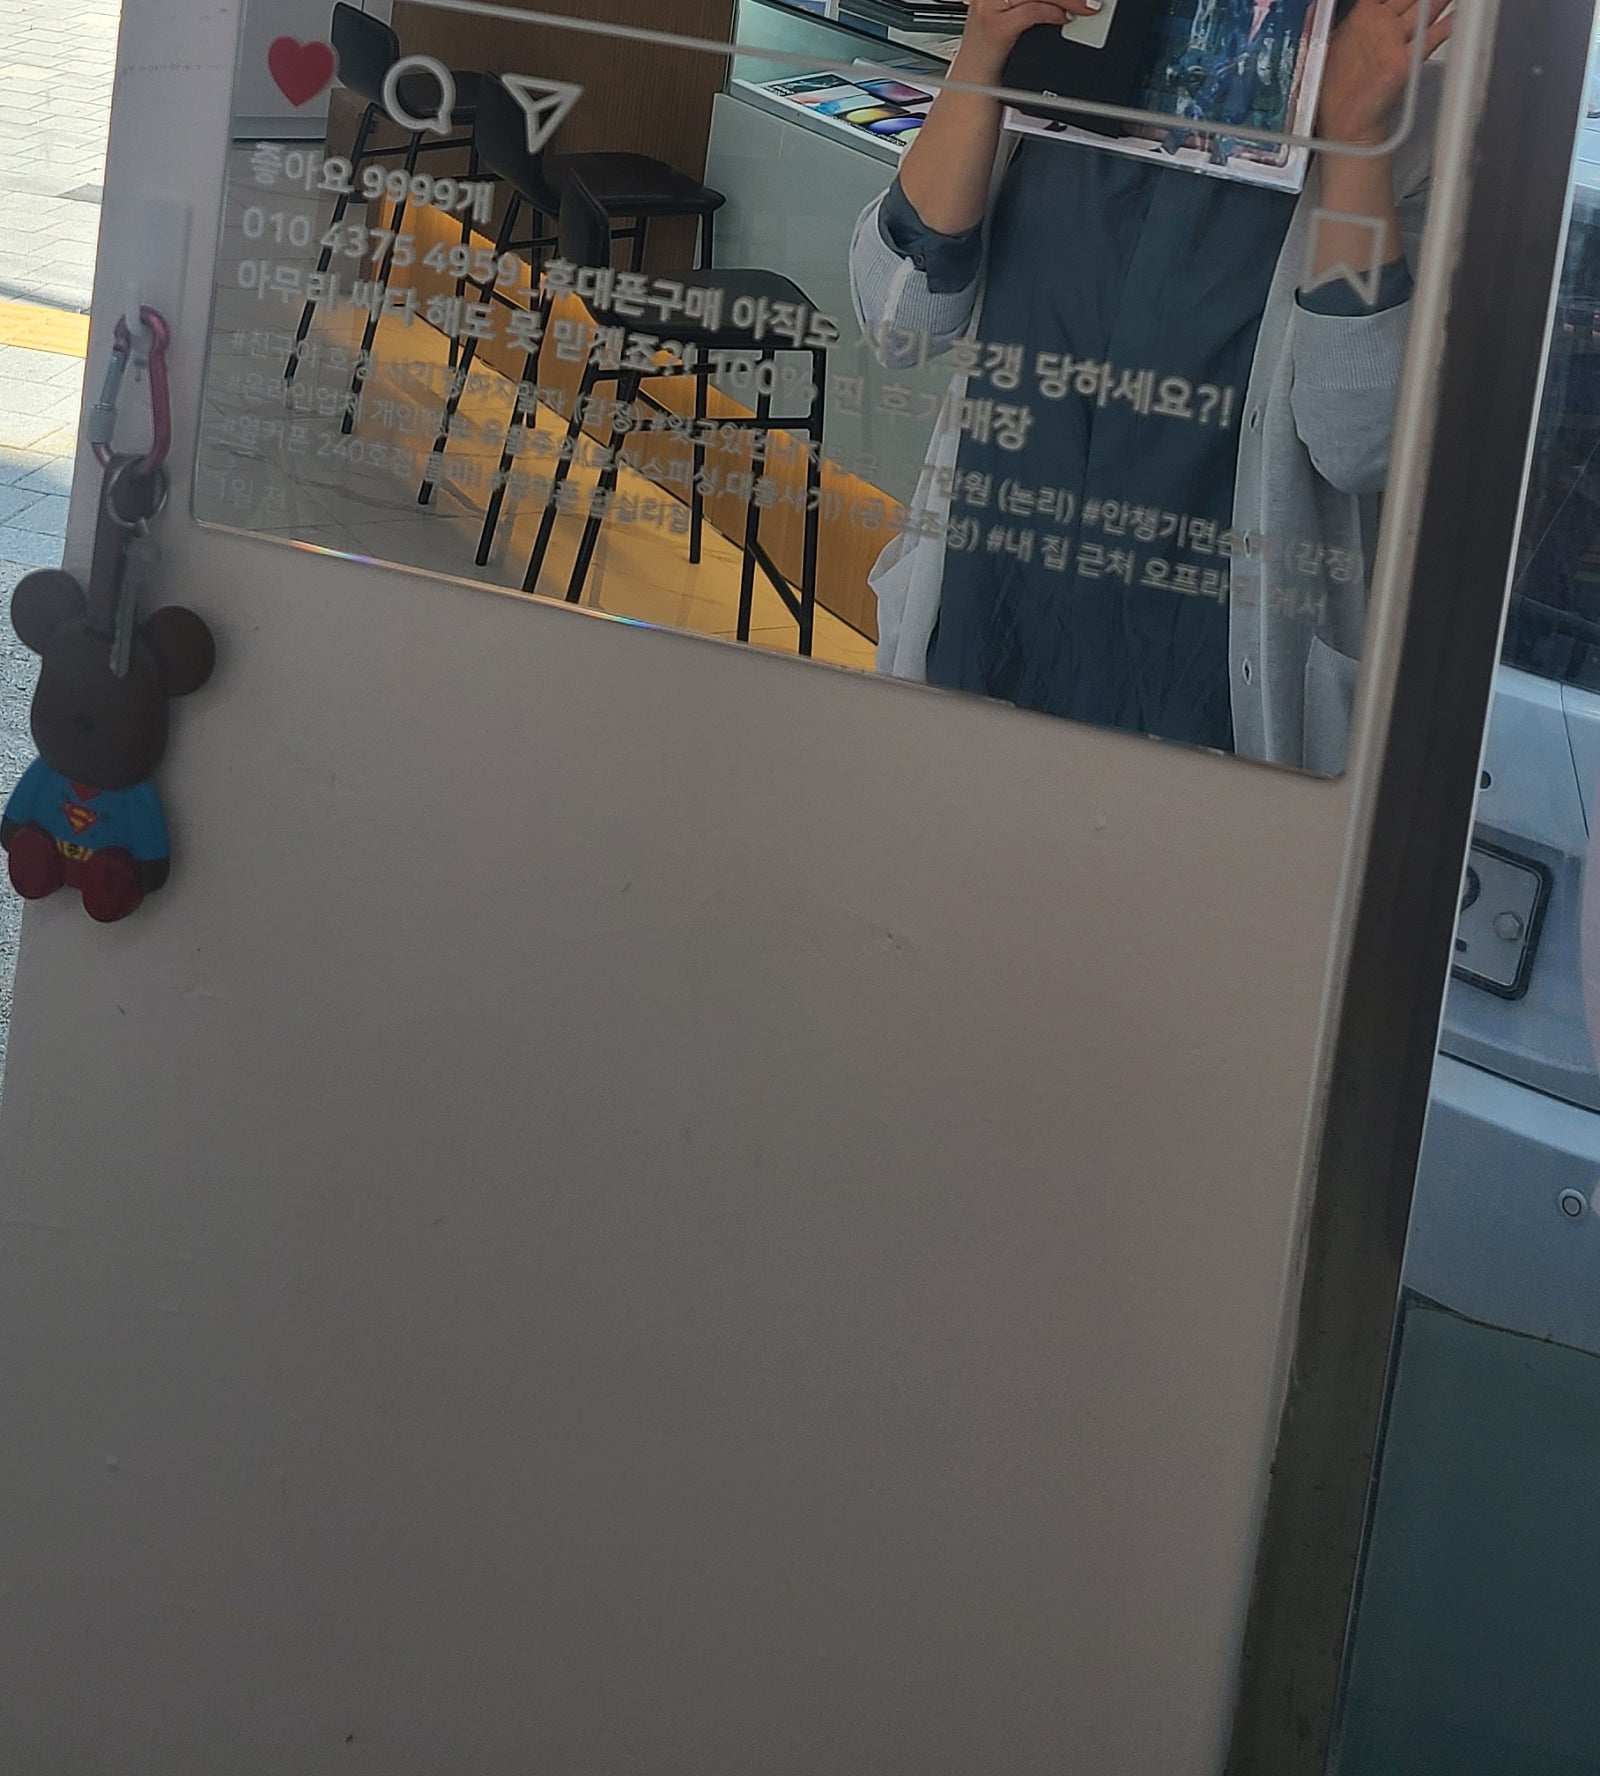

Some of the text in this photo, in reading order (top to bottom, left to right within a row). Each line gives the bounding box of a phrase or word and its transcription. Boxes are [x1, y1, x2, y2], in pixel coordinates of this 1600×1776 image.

[250, 141, 496, 224] 좋아요 9999개
[238, 260, 341, 310] 아무리
[350, 279, 423, 330] 싸다
[425, 294, 498, 343] 해도
[504, 308, 543, 355] 못
[708, 352, 823, 402] 100%
[242, 206, 313, 248] 010
[320, 222, 419, 267] 4375
[731, 296, 842, 349] 아직도
[1034, 349, 1236, 428] 당하세요?!
[316, 431, 416, 476] 240호점
[998, 476, 1078, 526] (논리)
[984, 524, 1037, 565] #내
[1041, 533, 1071, 573] 집
[1077, 541, 1135, 585] 근처
